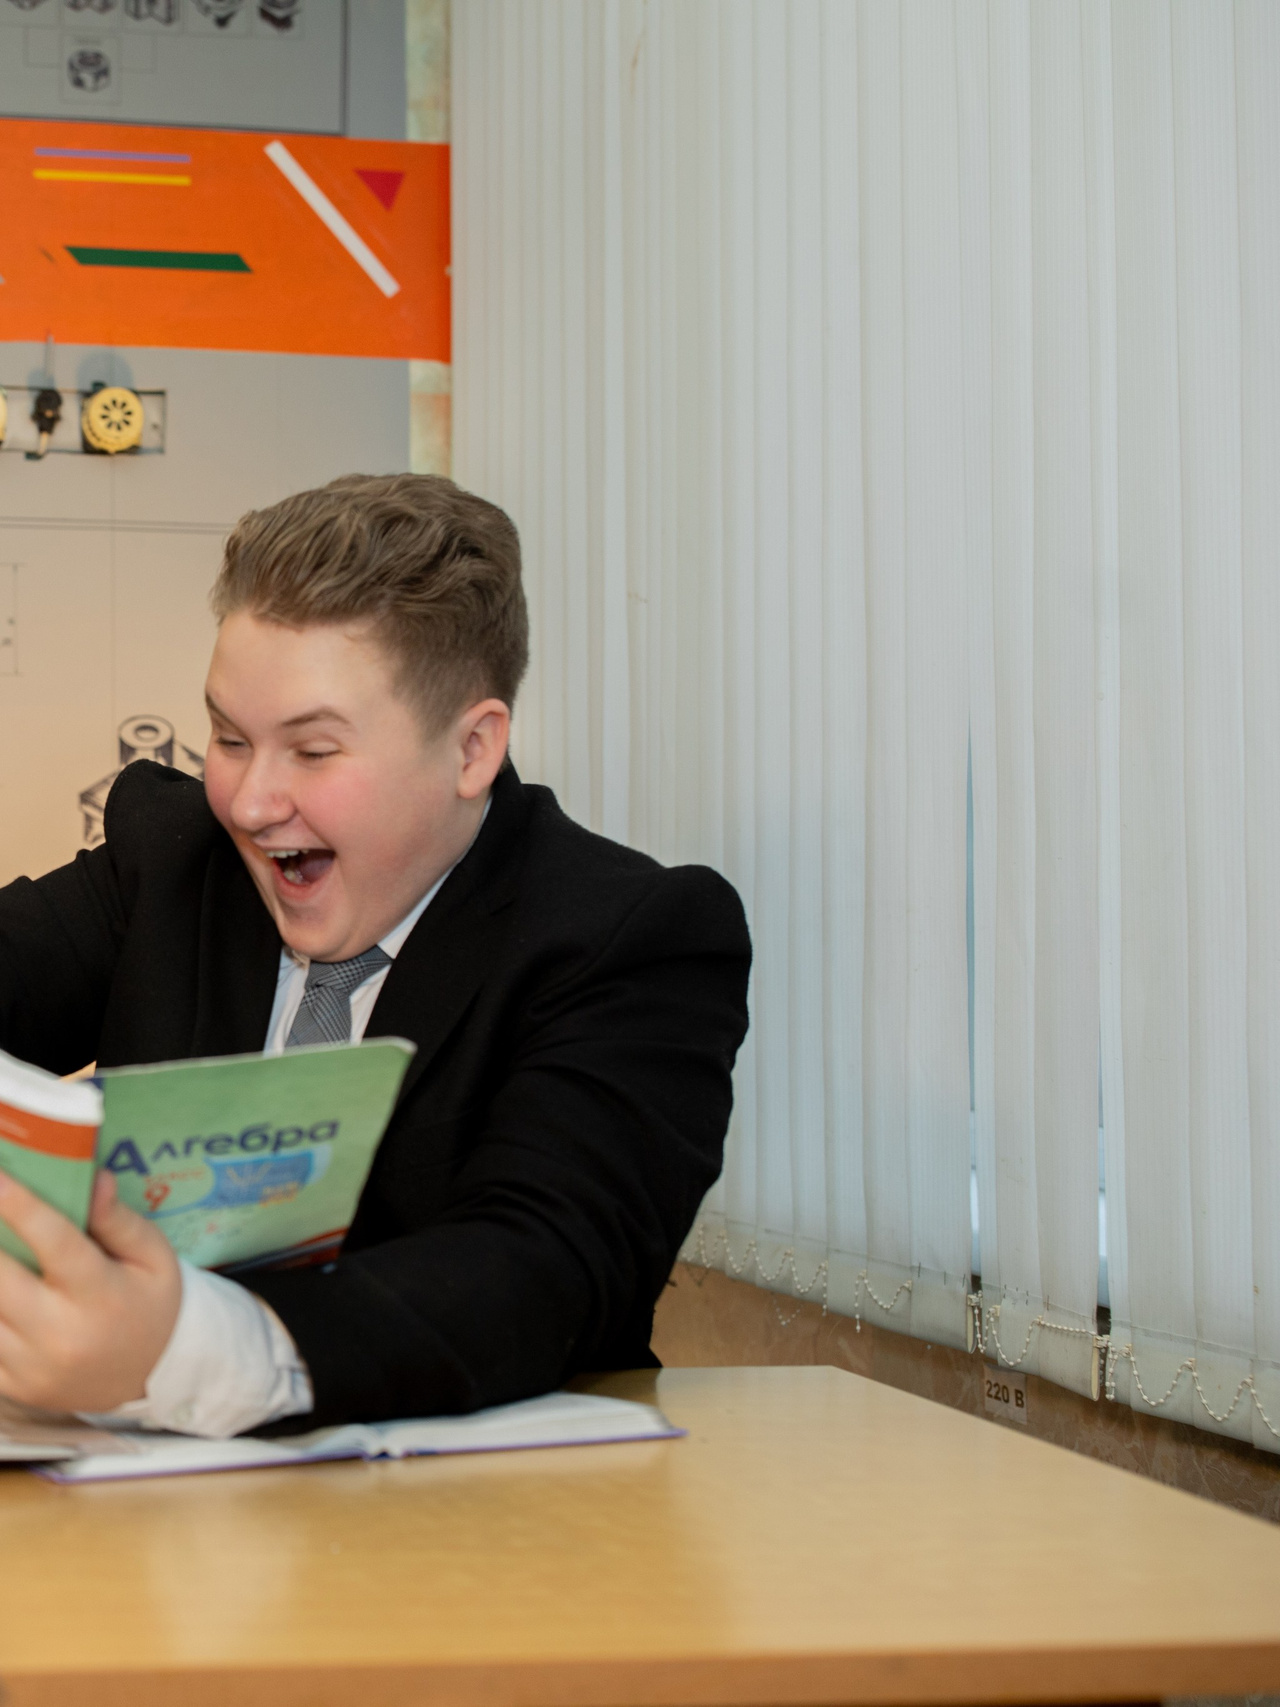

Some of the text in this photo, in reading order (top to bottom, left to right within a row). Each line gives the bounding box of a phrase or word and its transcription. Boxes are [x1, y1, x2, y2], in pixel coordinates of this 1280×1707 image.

[104, 1119, 340, 1176] Алгебра
[144, 1183, 172, 1212] 9
[986, 1380, 1010, 1404] 220
